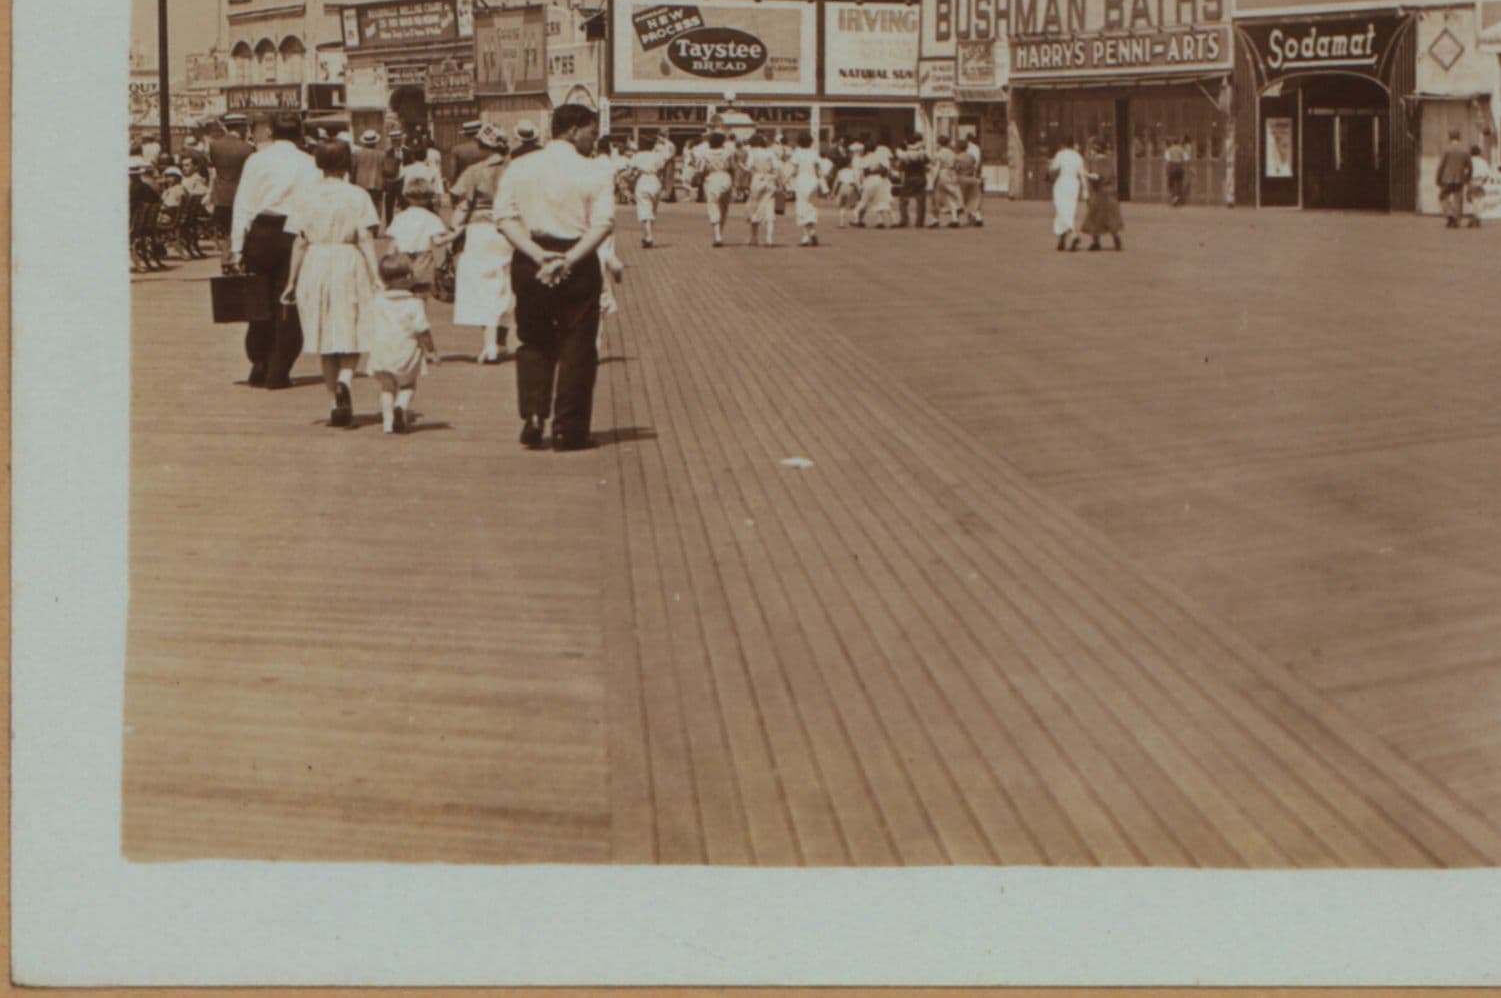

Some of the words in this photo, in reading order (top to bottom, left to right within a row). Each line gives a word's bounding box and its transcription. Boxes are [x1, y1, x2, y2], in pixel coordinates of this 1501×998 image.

[647, 8, 683, 29] NEW
[839, 8, 918, 34] IRVING
[641, 15, 701, 44] PROCESS
[676, 39, 762, 60] Taystee
[1267, 23, 1377, 68] Sodamat
[548, 55, 575, 75] ATHS
[692, 61, 747, 72] BREAD
[838, 68, 889, 79] NATURAL
[892, 69, 914, 79] SUN
[751, 108, 811, 121] ATHS
